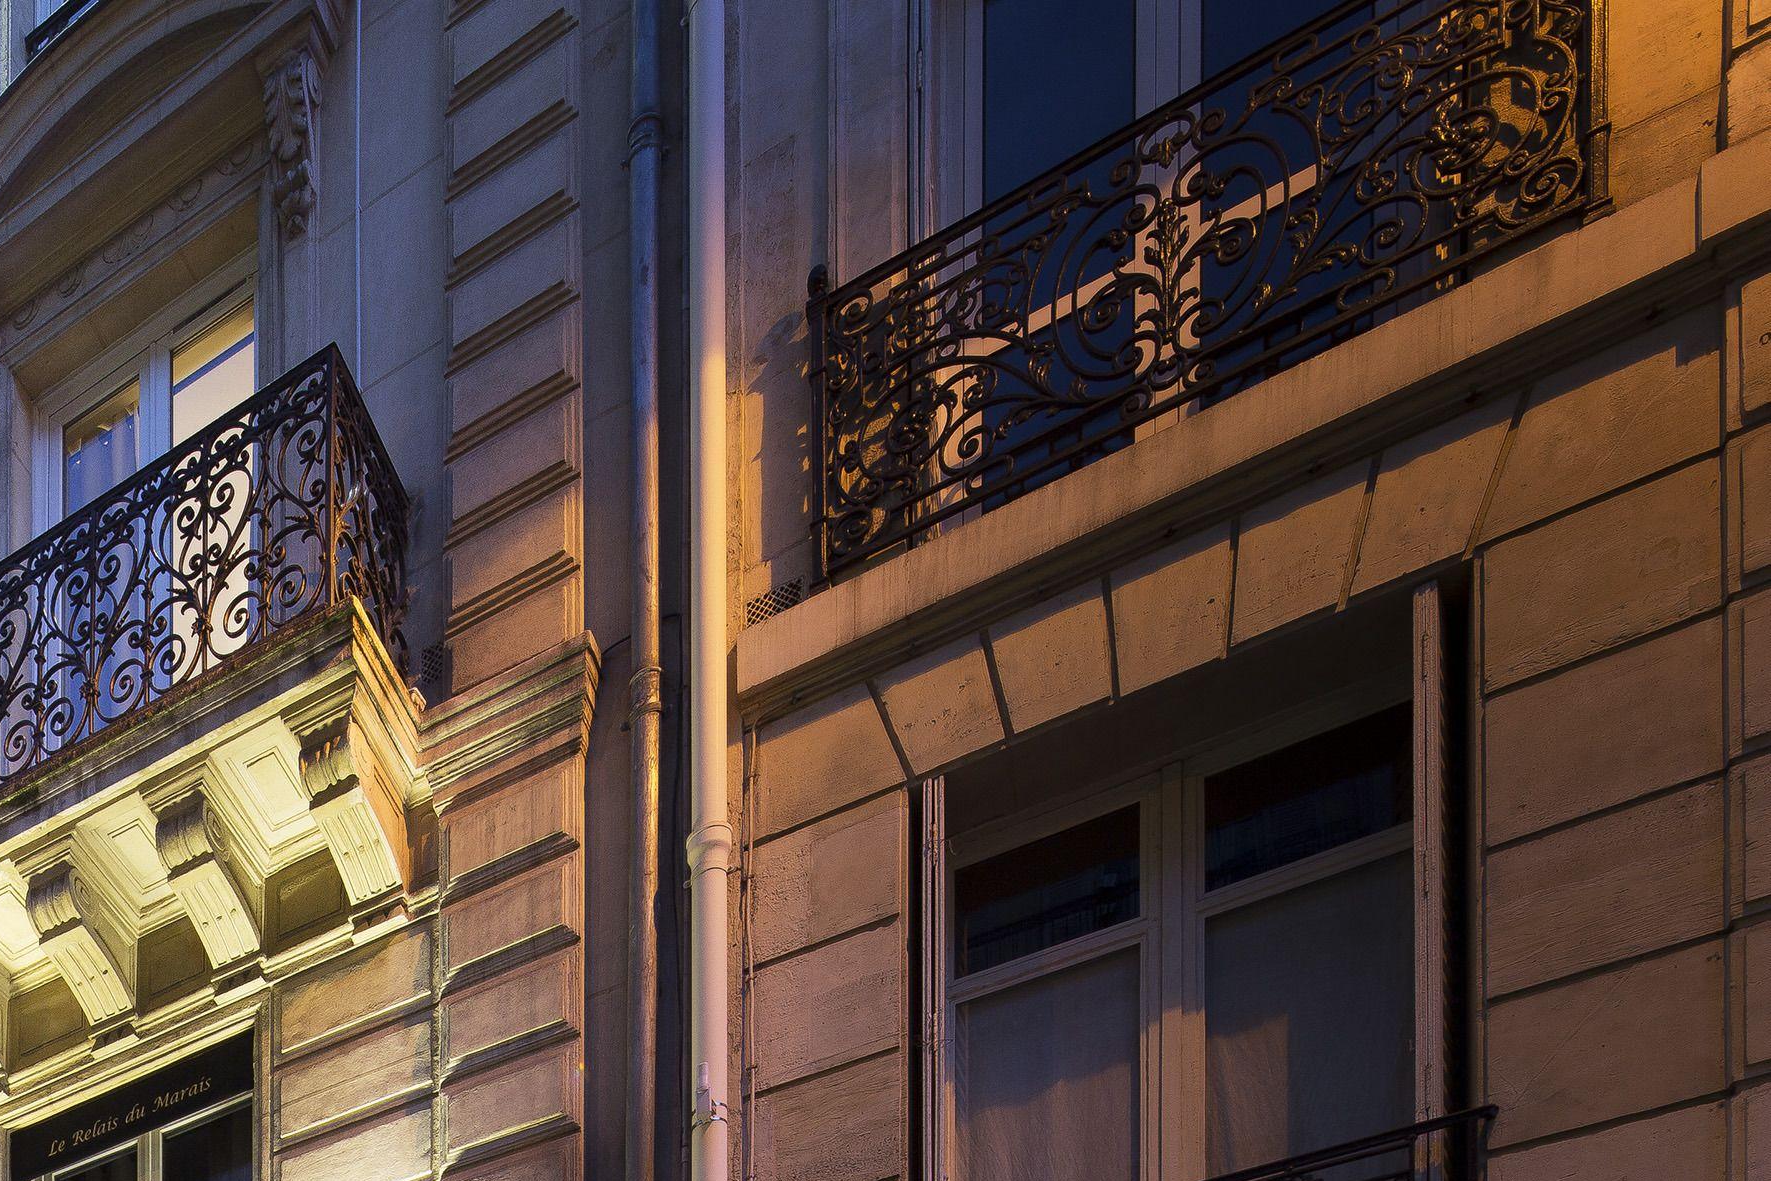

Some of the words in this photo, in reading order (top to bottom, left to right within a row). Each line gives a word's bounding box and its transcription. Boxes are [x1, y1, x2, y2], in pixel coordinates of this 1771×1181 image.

[48, 1137, 66, 1158] Le
[72, 1119, 119, 1147] Relais
[125, 1104, 146, 1124] du
[152, 1075, 212, 1113] Marais
